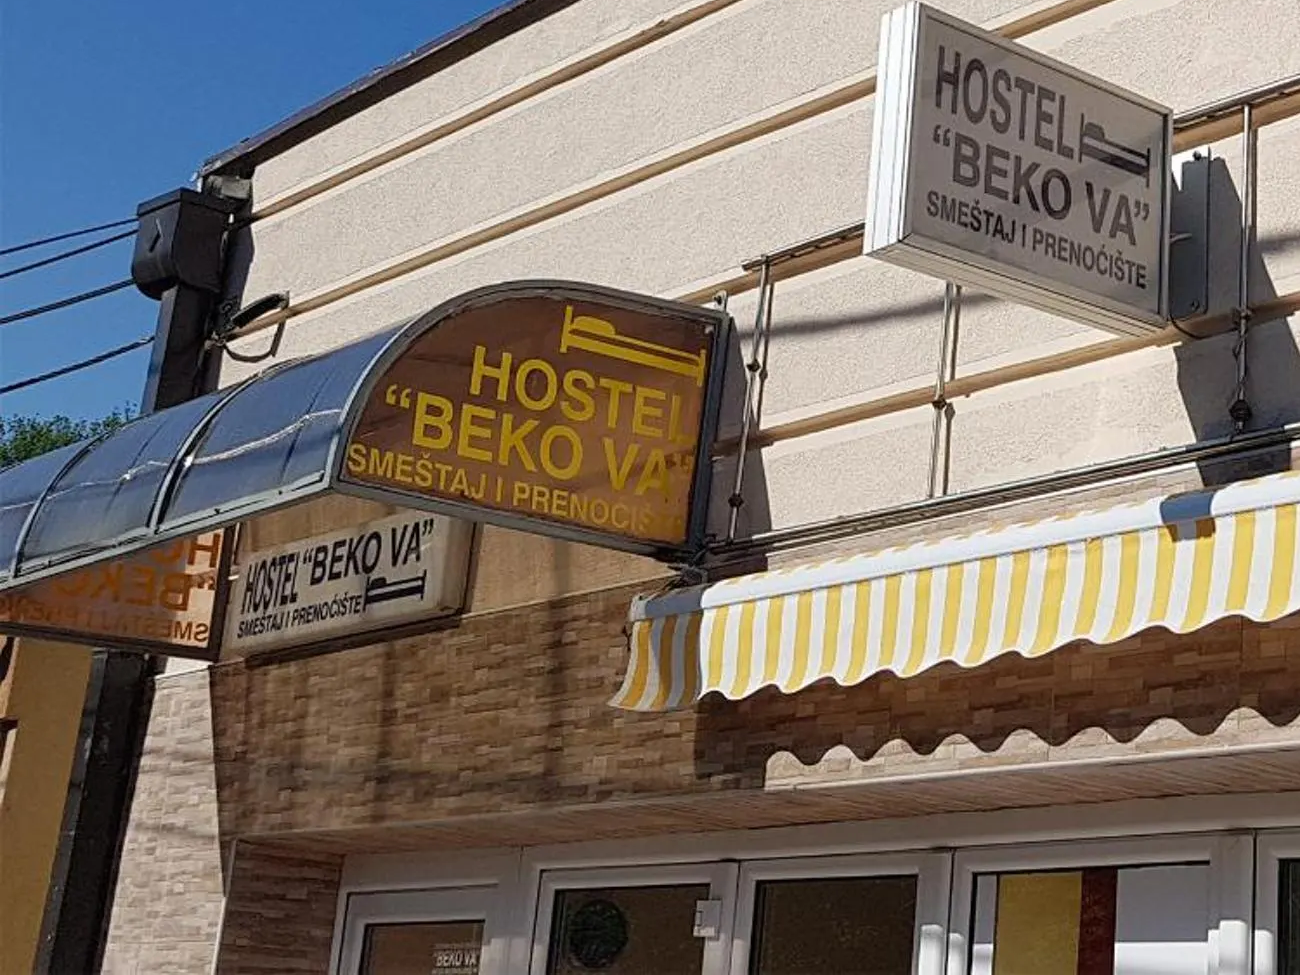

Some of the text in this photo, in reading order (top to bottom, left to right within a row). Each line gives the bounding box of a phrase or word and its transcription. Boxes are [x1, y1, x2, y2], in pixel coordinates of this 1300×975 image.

[935, 44, 1075, 160] HOSTEL
[932, 124, 1149, 246] “BEKO VA”
[927, 190, 1147, 289] SMEŠTAJ I PRENOĆIŠTE
[385, 384, 584, 480] “BEKO
[469, 344, 694, 446] HOSTEL
[347, 443, 488, 500] SMEŠTAJ
[495, 476, 502, 502] I
[237, 613, 285, 638] SMEŠTAJ
[292, 592, 363, 627] PRENOĆIŠTE
[241, 518, 434, 615] HOSTEL “BEKO VA”
